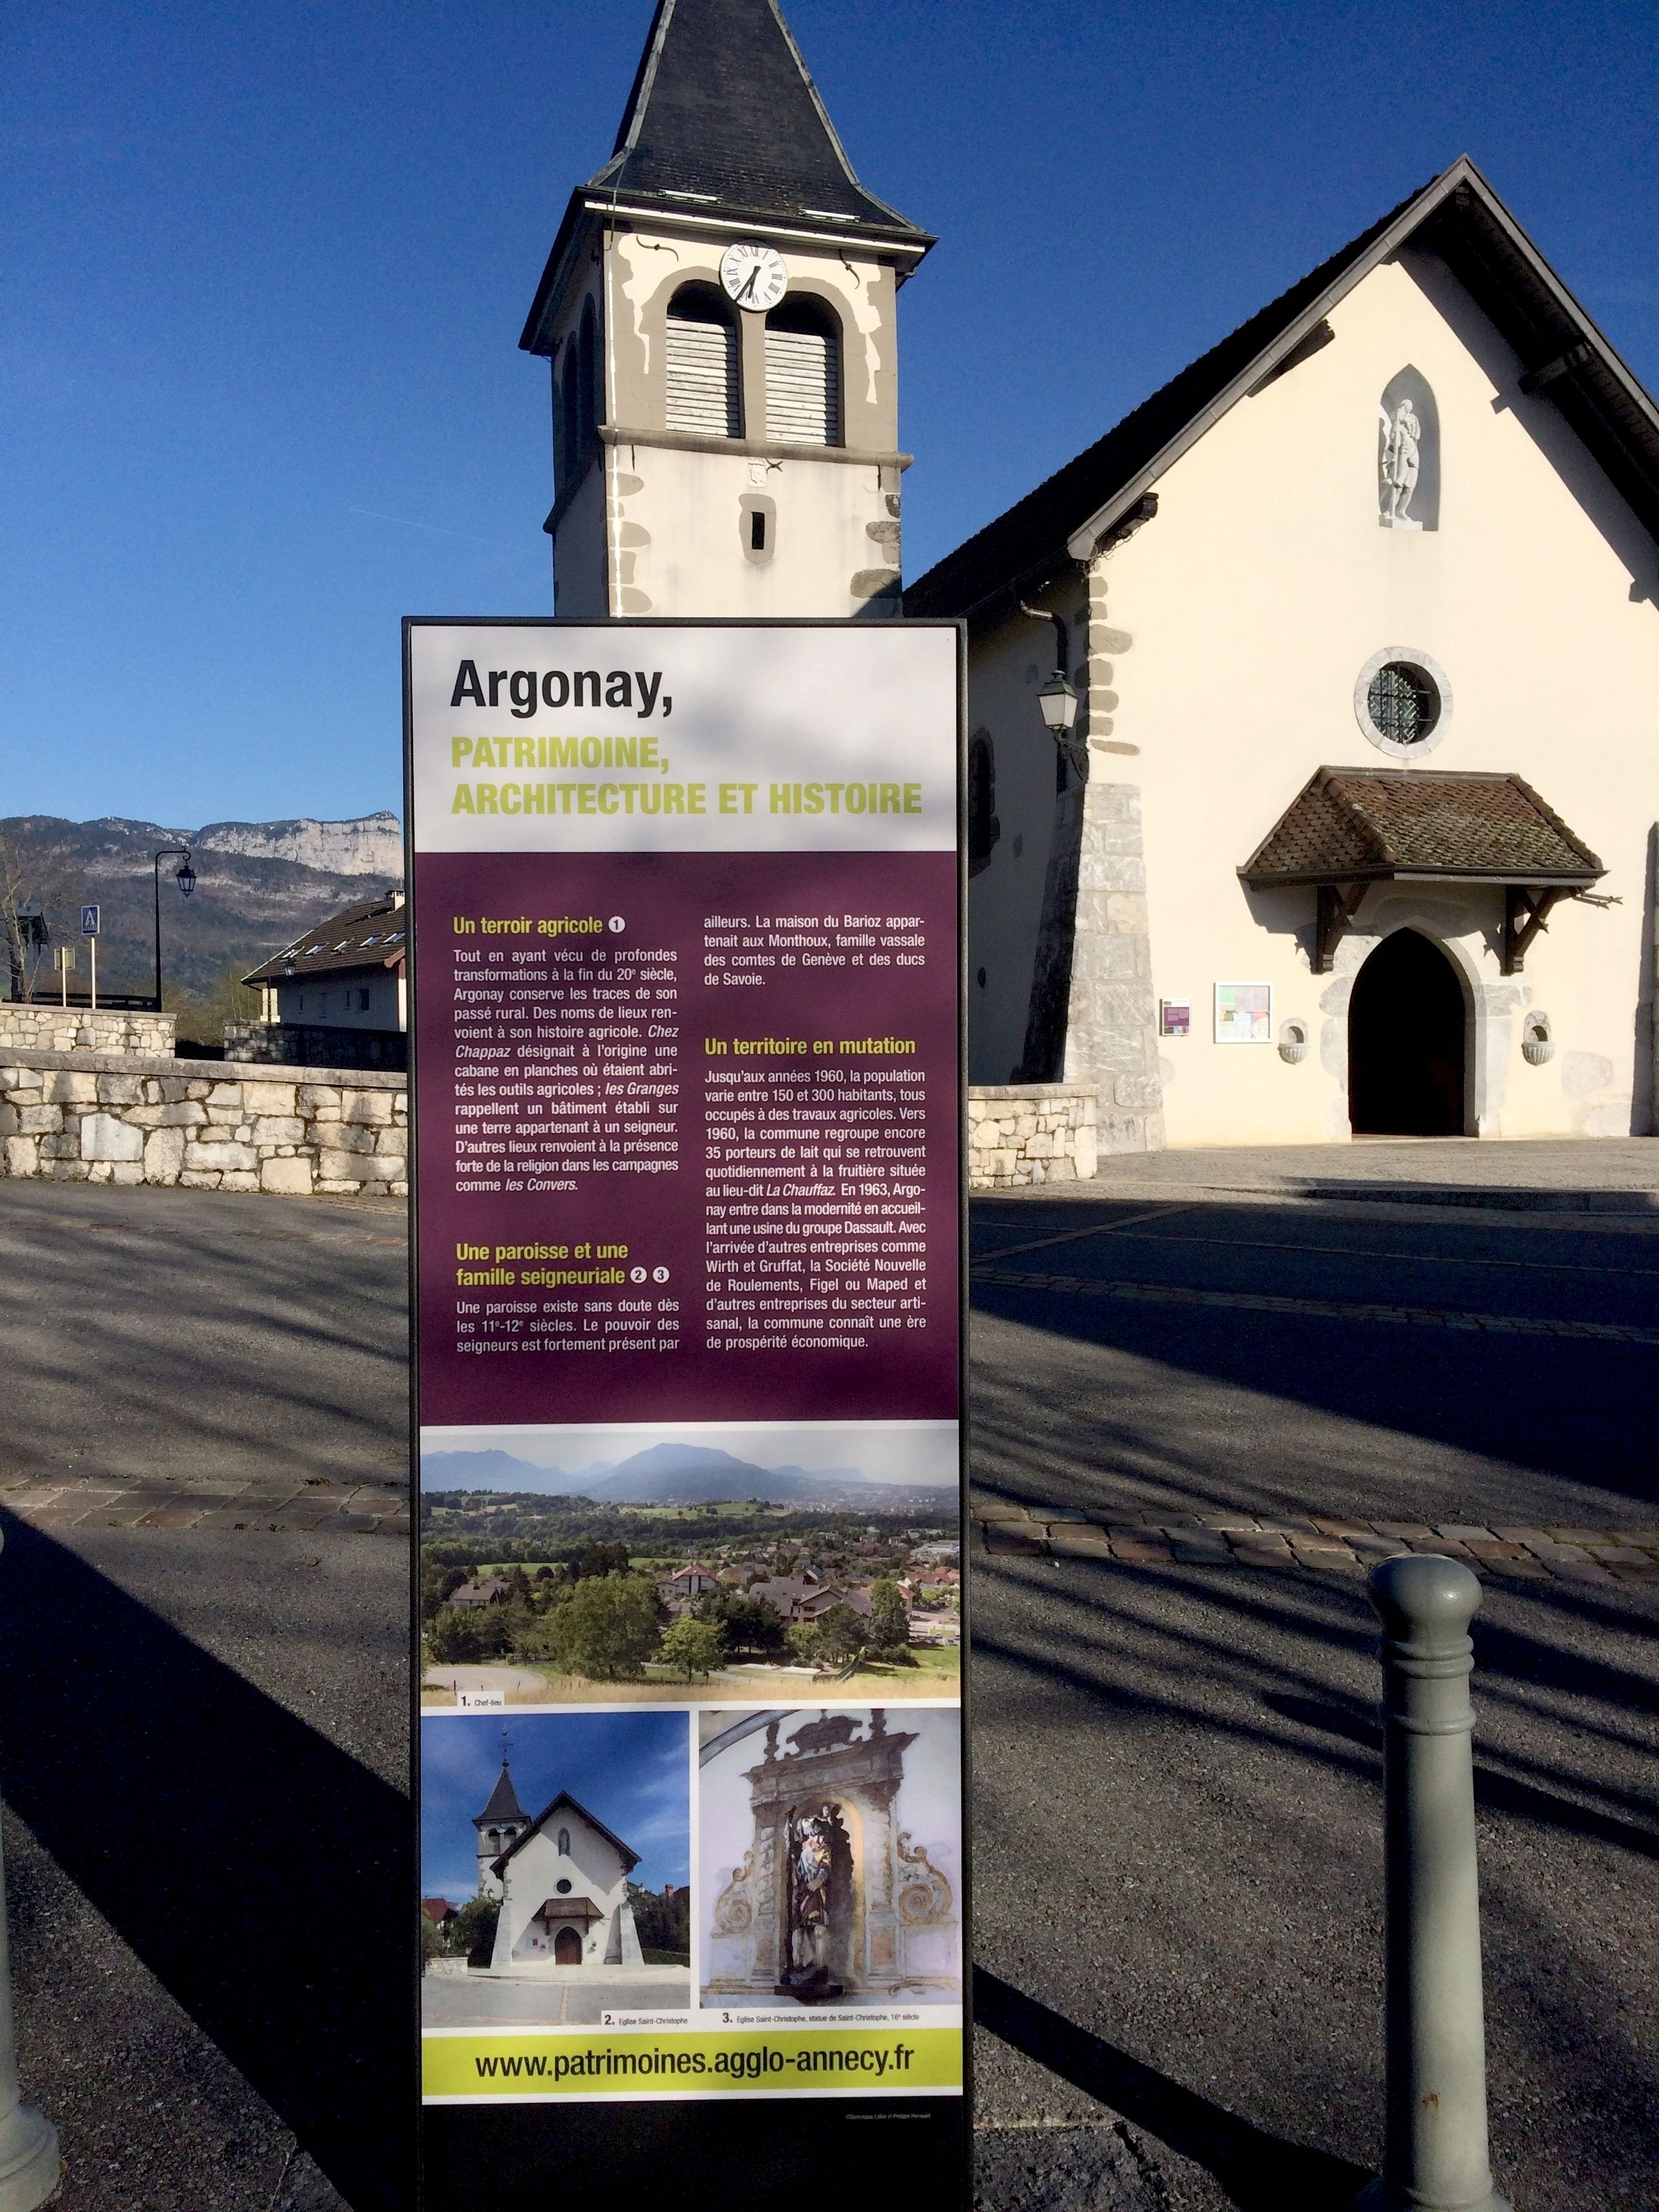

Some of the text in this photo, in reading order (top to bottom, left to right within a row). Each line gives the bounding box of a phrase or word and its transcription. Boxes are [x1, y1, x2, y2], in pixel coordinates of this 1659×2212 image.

[450, 659, 673, 718] Argonay,
[451, 737, 670, 775] PATRIMOINE,
[451, 783, 922, 815] ARCHITECTURE ET HISTOIRE
[453, 916, 476, 935] Un
[480, 916, 533, 934] terroir
[537, 916, 603, 938] agricole
[703, 914, 925, 930] ailleurs. La maison du Barioz appar-
[703, 933, 925, 949] tenait aux Monthoux, famille vassale
[453, 948, 678, 965] Tout en ayant vécu de profondes
[453, 968, 548, 982] transformations
[552, 967, 560, 981] à
[563, 968, 575, 981] la
[577, 968, 594, 981] fin
[597, 968, 613, 981] du
[640, 966, 677, 983] siècle,
[704, 972, 766, 985] de Savoie.
[454, 1024, 680, 1041] voient à son histoire agricole. Chez
[455, 1044, 512, 1061] Chappaz
[517, 1044, 575, 1060] désignait
[581, 1043, 590, 1057] à
[655, 1046, 678, 1057] une
[705, 1036, 916, 1055] Un territoire en mutation
[768, 1069, 811, 1083] années
[814, 1069, 846, 1084] 1960,
[850, 1069, 861, 1082] la
[863, 1069, 925, 1085] population
[455, 1100, 679, 1118] rappellent un bâtiment établi sur
[705, 1126, 926, 1142] 1960, la commune regroupe encore
[508, 1140, 537, 1153] lieux
[540, 1139, 596, 1153] renvoient
[598, 1139, 607, 1152] à
[609, 1139, 621, 1152] la
[623, 1138, 679, 1155] présence
[705, 1163, 926, 1181] quotidiennement à la fruitière située
[455, 1177, 578, 1192] comme les Convers.
[705, 1183, 926, 1198] au lieu-dit La Chauffaz. En 1963, Argo-
[456, 1242, 629, 1264] Une paroisse et une
[810, 1240, 879, 1256] entreprises
[881, 1242, 926, 1253] comme
[705, 1258, 926, 1274] Wirth et Gruffat, la Société Nouvelle
[455, 1268, 516, 1286] famille
[520, 1267, 626, 1288] seigneuriale
[705, 1277, 927, 1294] de Roulements, Figel ou Maped et
[457, 1320, 475, 1333] les
[529, 1318, 577, 1332] siècles.
[583, 1318, 598, 1332] Le
[605, 1317, 652, 1334] pouvoir
[657, 1317, 680, 1331] des
[706, 1314, 926, 1332] sanal, la commune connaît une ère
[706, 1334, 869, 1351] de prospérité économique.
[461, 1696, 470, 1706] 1.
[604, 2014, 615, 2025] 2.
[638, 2018, 688, 2026] Saint-Christophe
[722, 2012, 733, 2023] 3.
[476, 2043, 915, 2081] www.patrimoines.agglo-annecy.fr
